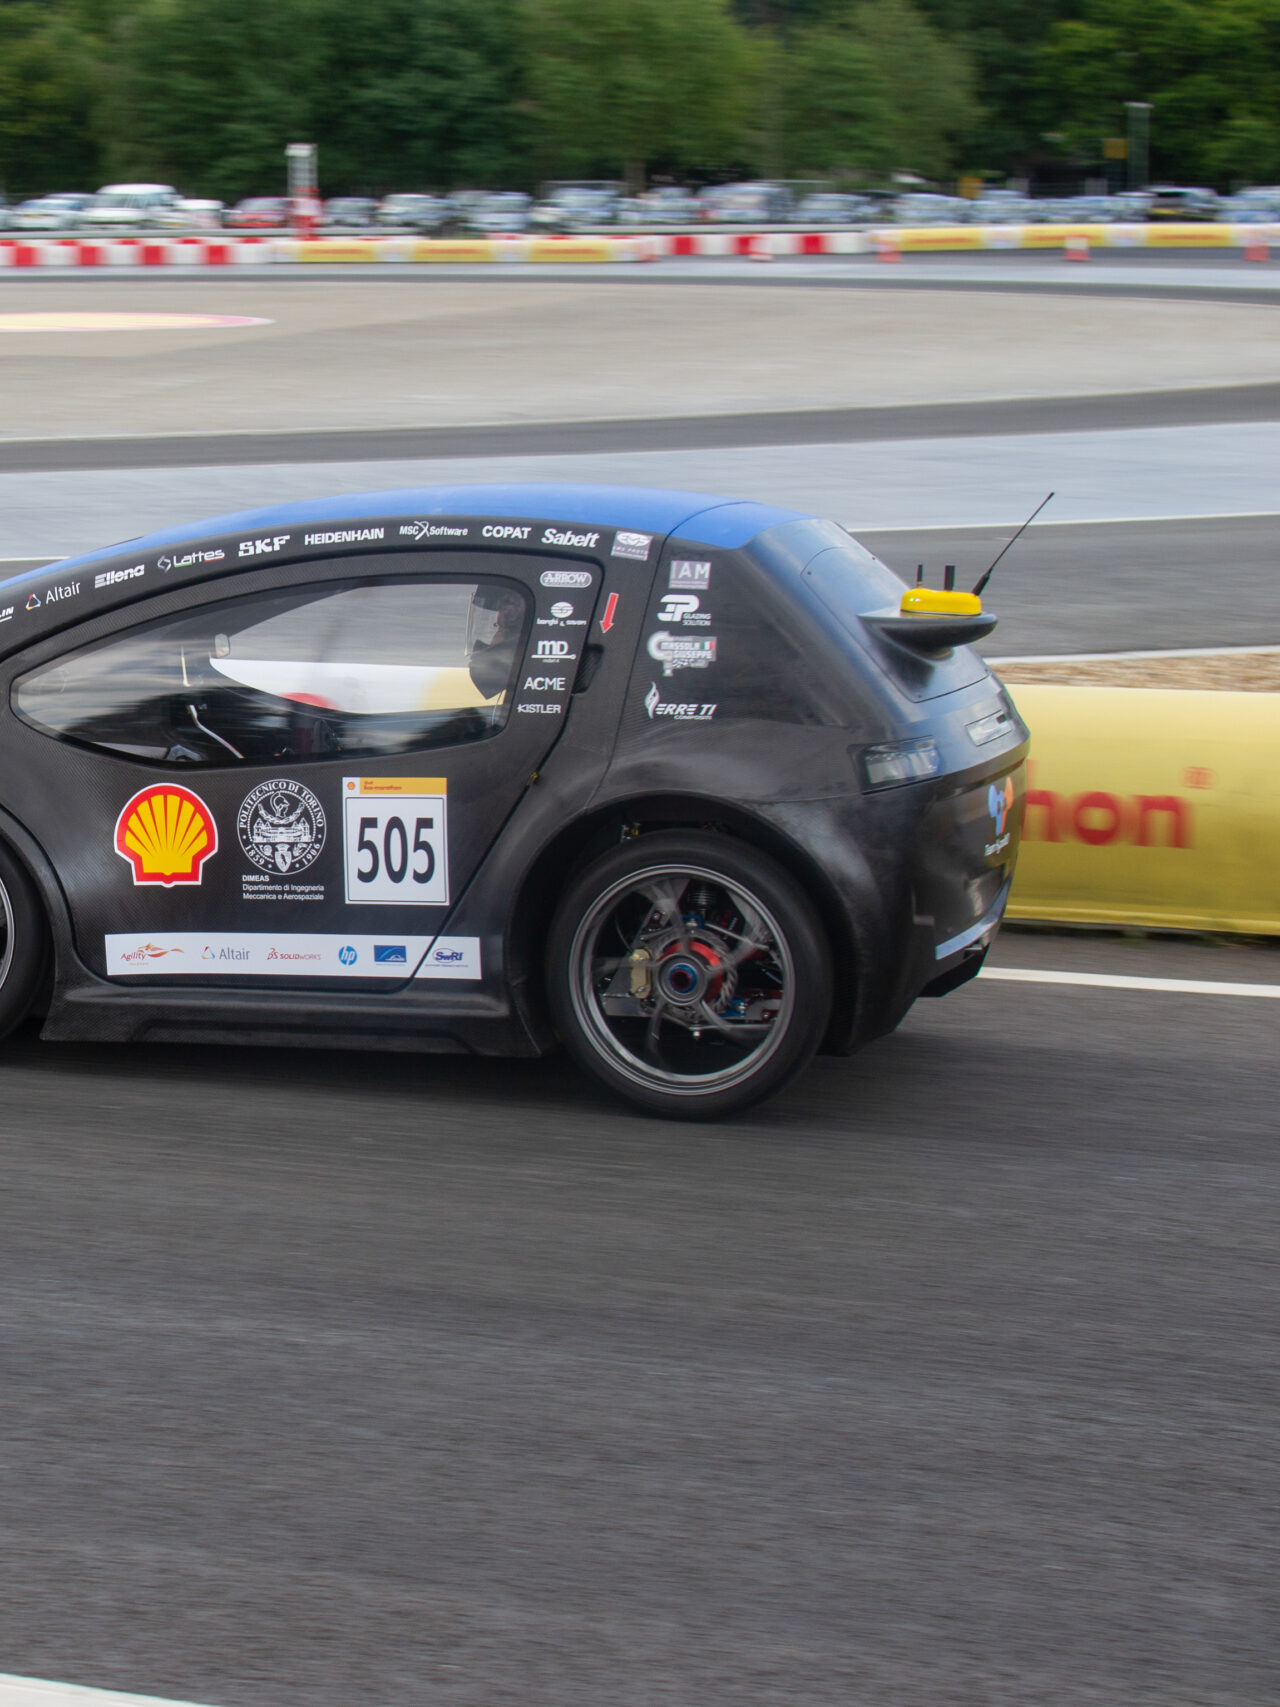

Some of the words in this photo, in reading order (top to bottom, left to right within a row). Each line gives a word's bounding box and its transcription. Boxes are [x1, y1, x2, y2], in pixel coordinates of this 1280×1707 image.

[304, 528, 385, 545] HEIDENHAIN
[399, 525, 419, 535] MSC
[430, 525, 469, 536] Software
[482, 525, 532, 539] COPAT
[541, 528, 600, 548] Sabelt
[238, 534, 291, 557] SKF
[173, 549, 225, 567] Lattes
[94, 564, 145, 589] Ellena
[544, 573, 587, 583] ARROW
[45, 581, 81, 604] Altair
[523, 677, 566, 690] ACME
[517, 704, 562, 713] KISTLER
[239, 781, 287, 828] POLITECNICO
[288, 781, 300, 793] DI
[301, 789, 324, 828] TORINO
[1020, 760, 1195, 850] hon
[245, 844, 265, 865] 1859
[301, 842, 321, 865] 1906
[357, 816, 436, 884] 505
[242, 874, 270, 882] DIMEAS
[242, 883, 283, 891] Dipartimento
[283, 883, 290, 891] di
[291, 884, 325, 893] Ingegneria
[243, 892, 277, 900] Meccanica
[283, 893, 325, 901] Aerospaziale
[121, 950, 147, 961] Agility
[219, 947, 250, 960] Altair
[340, 946, 356, 965] hp
